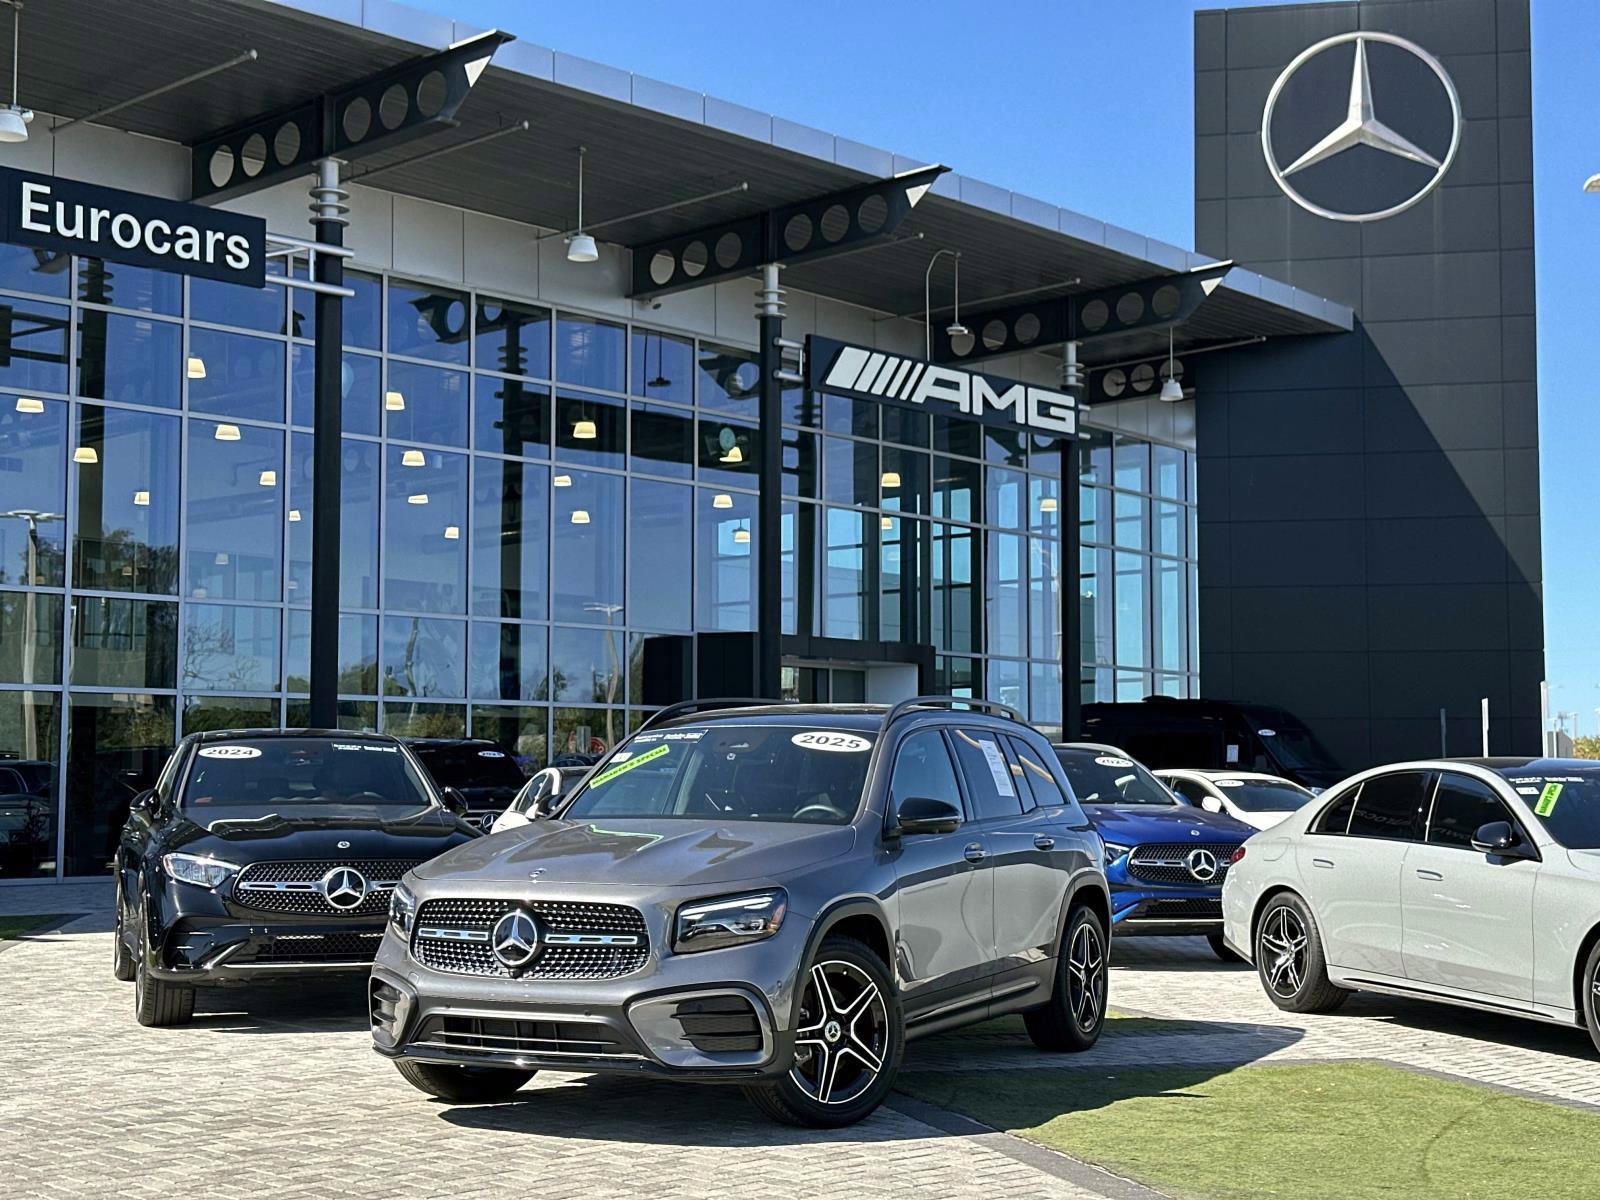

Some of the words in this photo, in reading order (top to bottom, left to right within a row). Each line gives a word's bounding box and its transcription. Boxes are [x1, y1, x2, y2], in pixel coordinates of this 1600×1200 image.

[21, 181, 250, 270] Eurocars
[911, 365, 1076, 435] AMG
[206, 748, 253, 757] 2024
[800, 734, 862, 749] 2025
